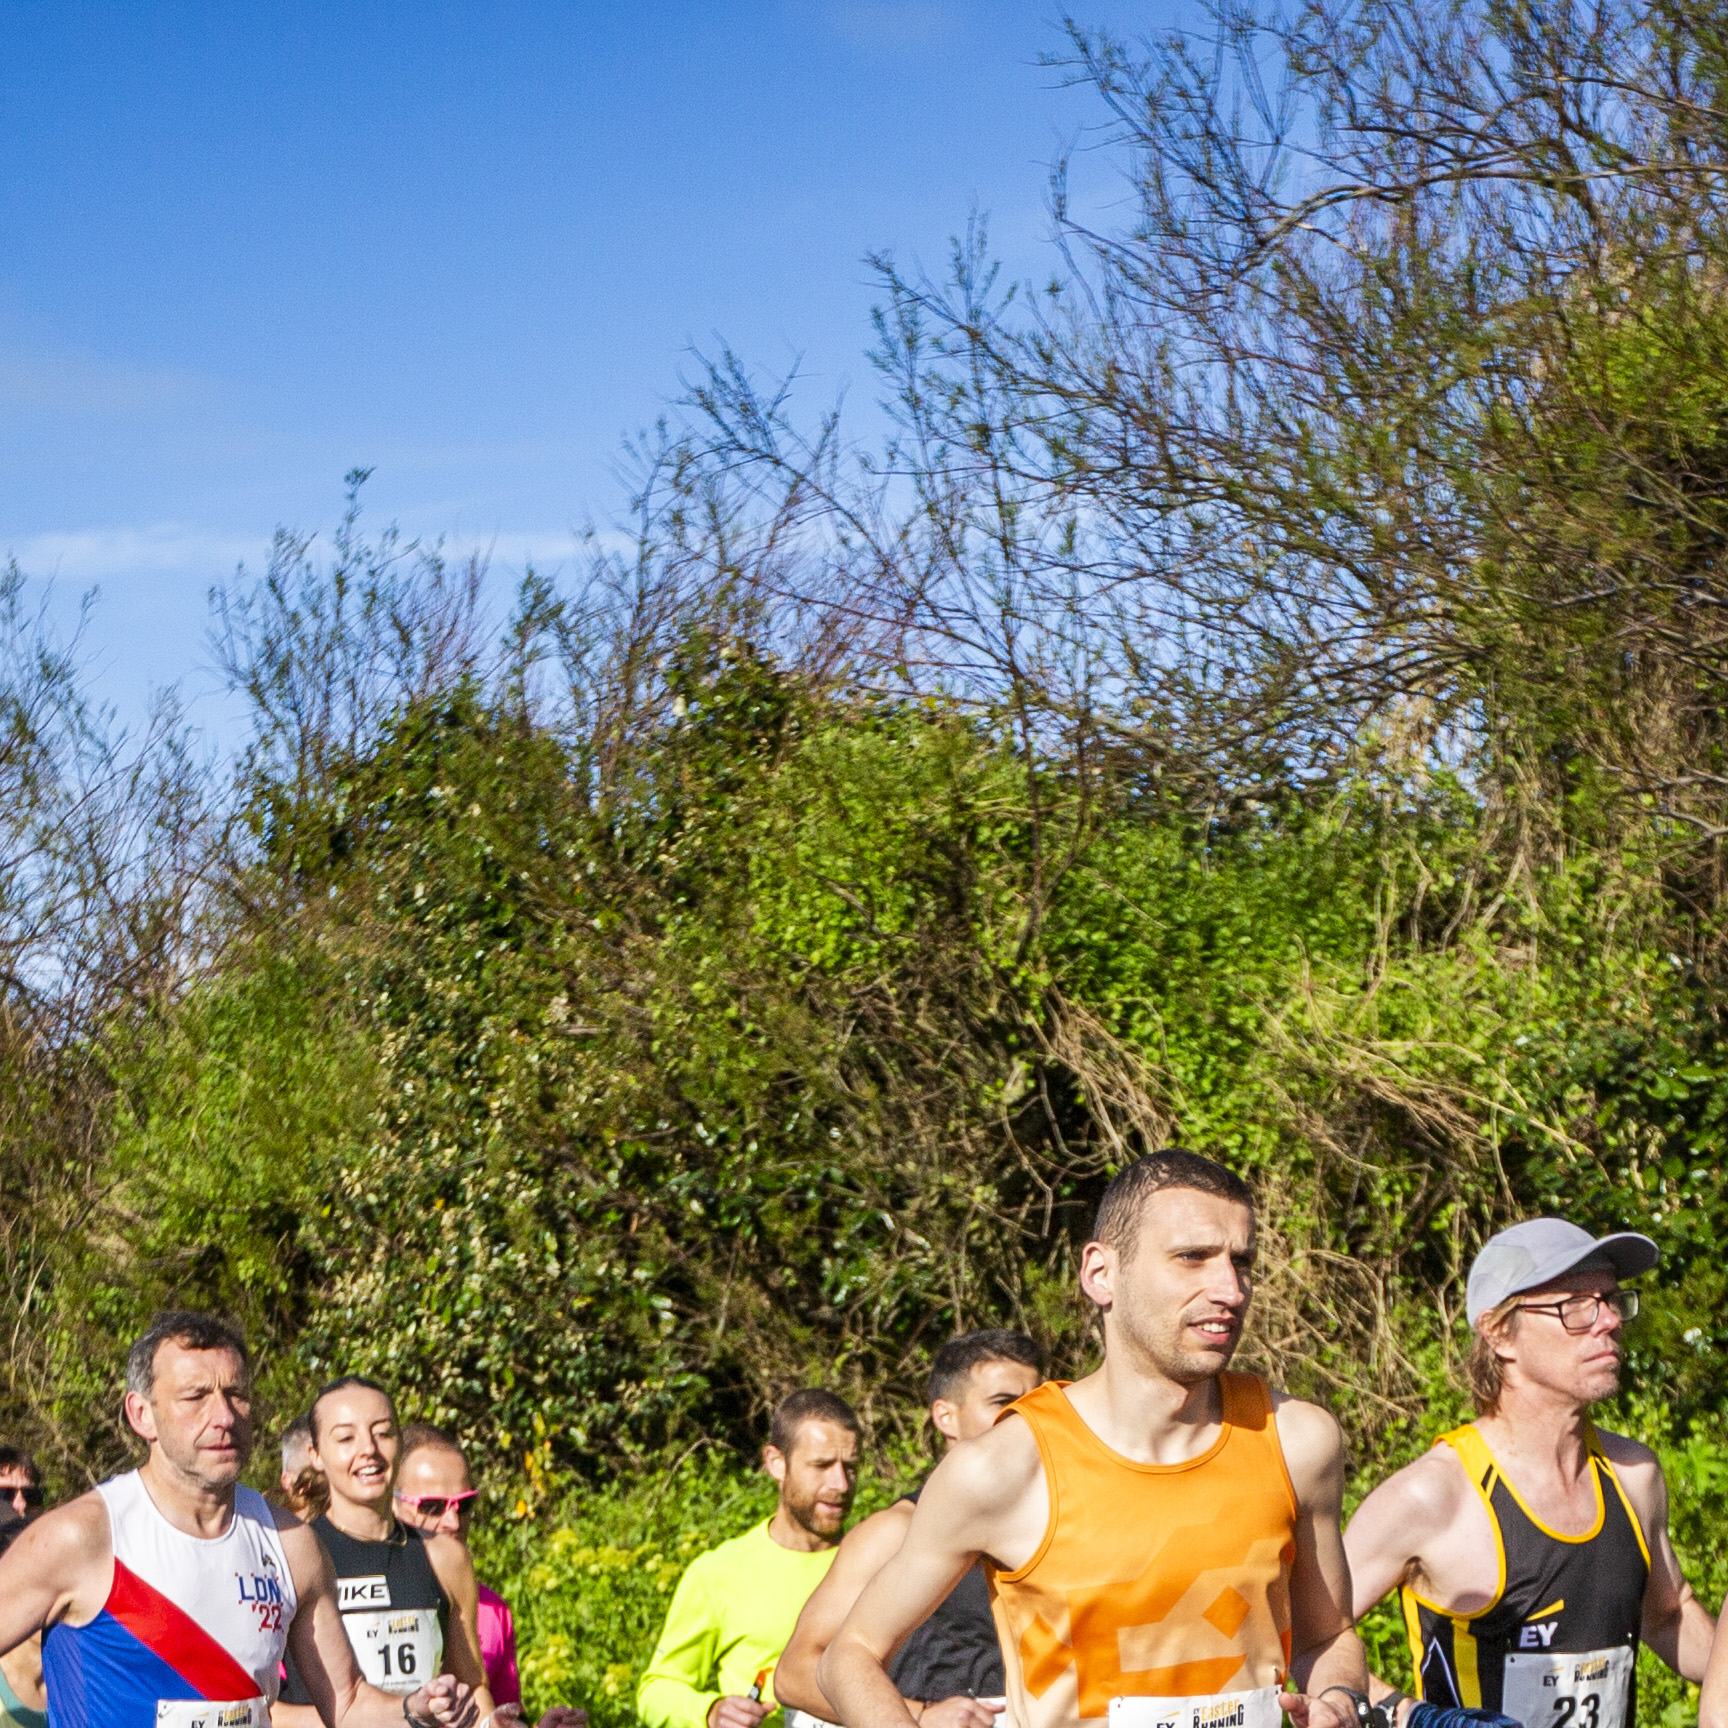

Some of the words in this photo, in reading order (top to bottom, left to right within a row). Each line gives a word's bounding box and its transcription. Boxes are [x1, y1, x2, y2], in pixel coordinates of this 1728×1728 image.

[238, 1576, 282, 1603] LDN
[1518, 1621, 1559, 1648] EY
[377, 1642, 417, 1676] 16
[1542, 1675, 1559, 1687] EY
[1201, 1698, 1240, 1721] Easter
